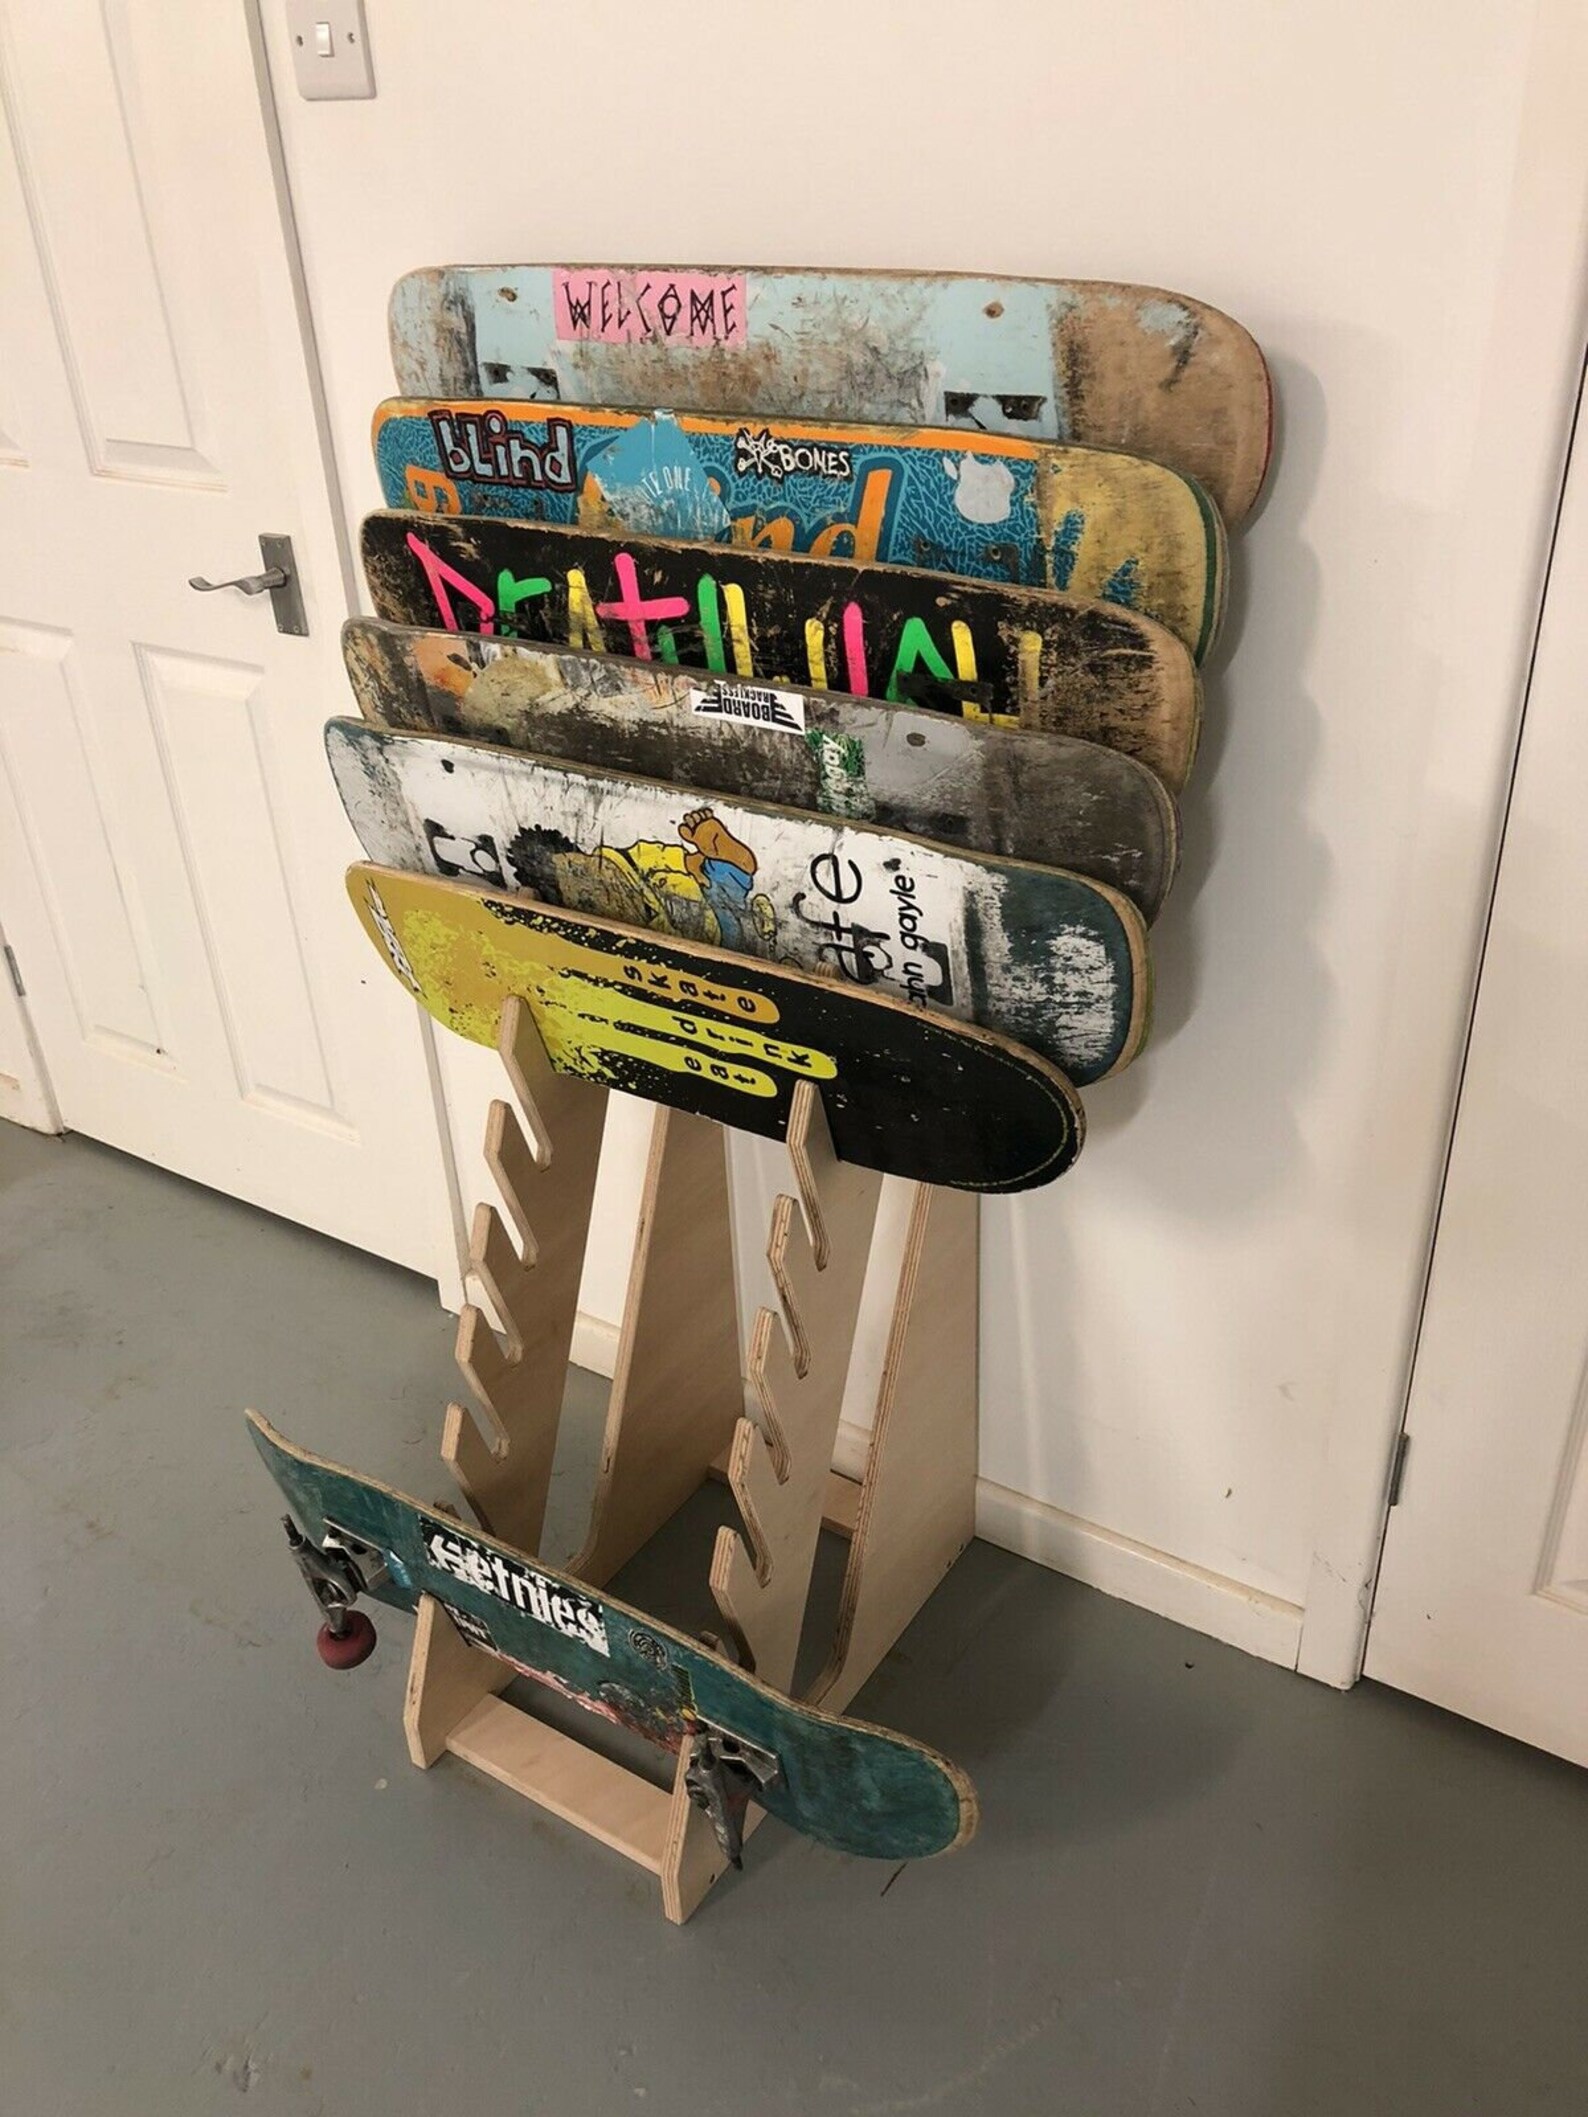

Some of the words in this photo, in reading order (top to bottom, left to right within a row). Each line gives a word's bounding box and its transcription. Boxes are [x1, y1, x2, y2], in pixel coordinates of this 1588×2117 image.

[563, 280, 738, 341] WELCOME
[779, 443, 852, 477] BONES
[722, 697, 771, 722] BOARD
[889, 874, 932, 951] gayle
[623, 964, 757, 1014] skate
[672, 1015, 813, 1069] drink
[684, 1056, 757, 1086] eat
